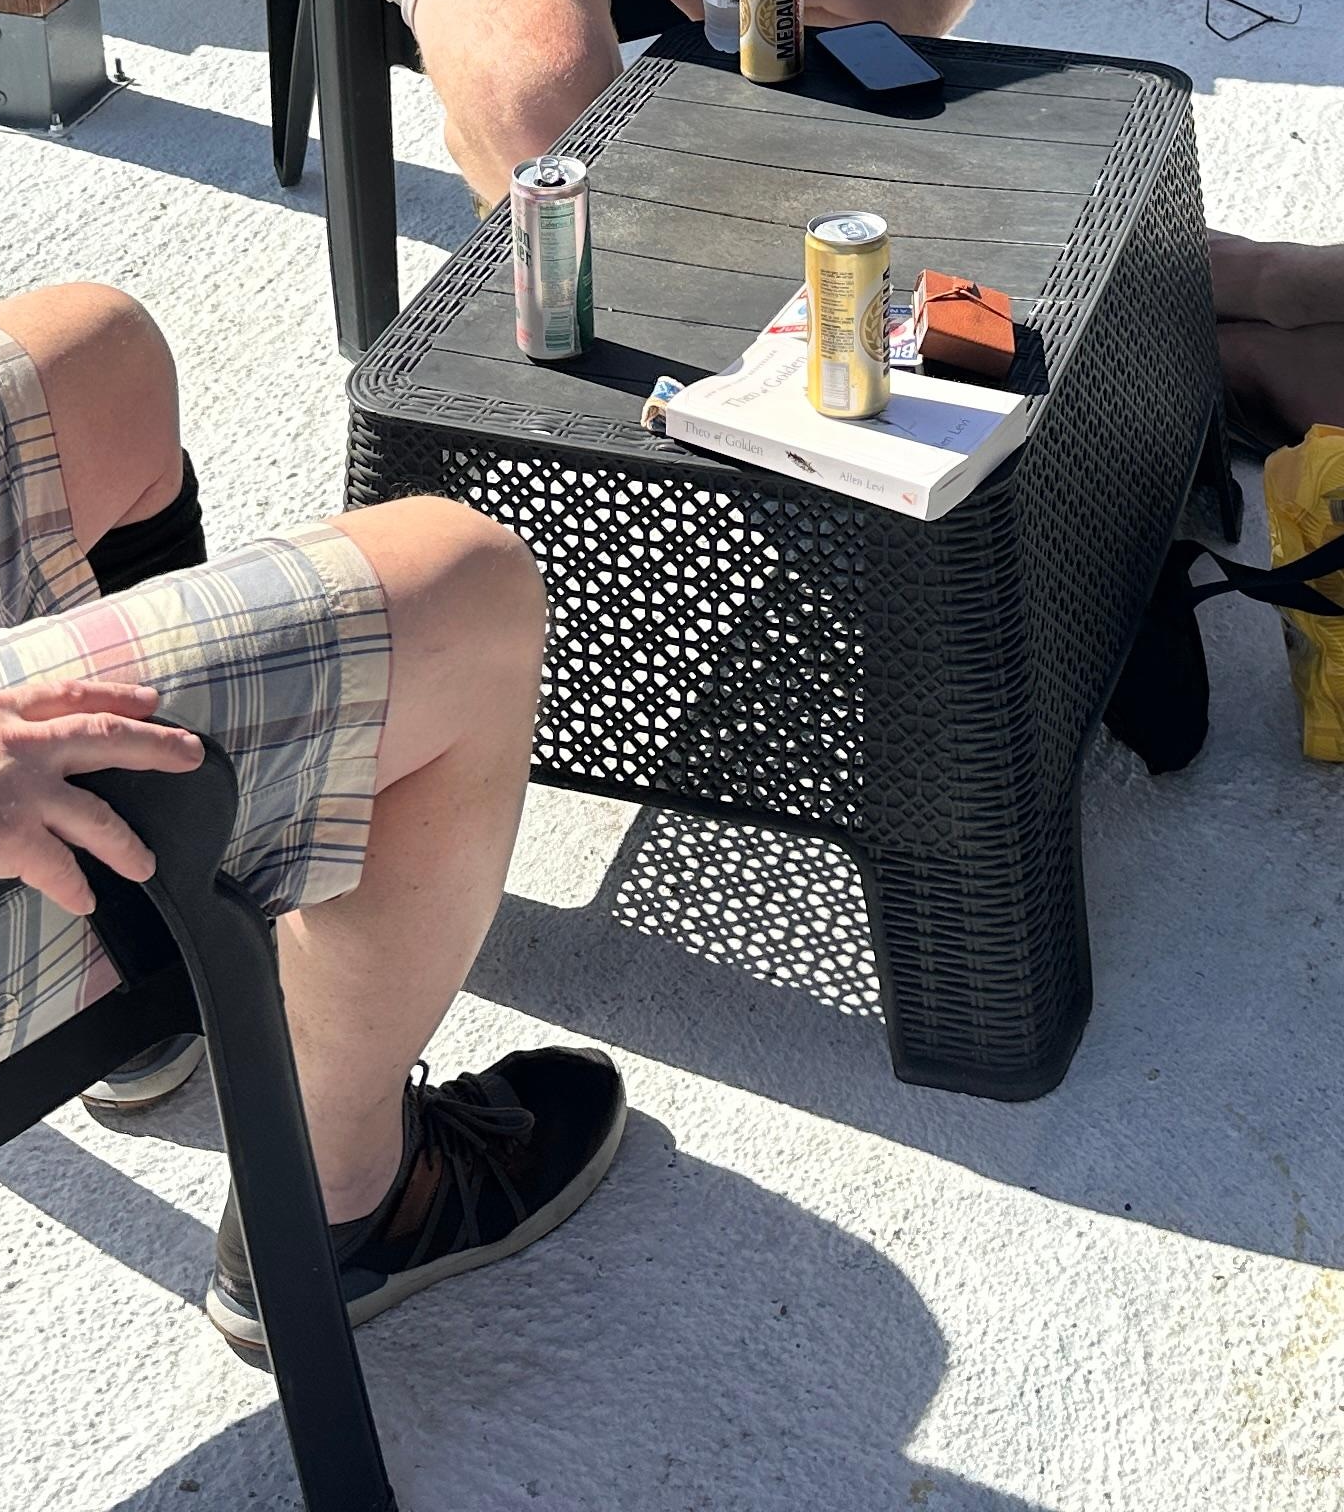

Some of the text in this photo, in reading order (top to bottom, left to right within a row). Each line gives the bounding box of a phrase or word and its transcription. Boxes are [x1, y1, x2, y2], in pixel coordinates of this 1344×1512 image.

[763, 355, 807, 388] Golden
[682, 420, 710, 438] Theo
[725, 433, 764, 456] Golden
[840, 471, 885, 493] Allen Levi
